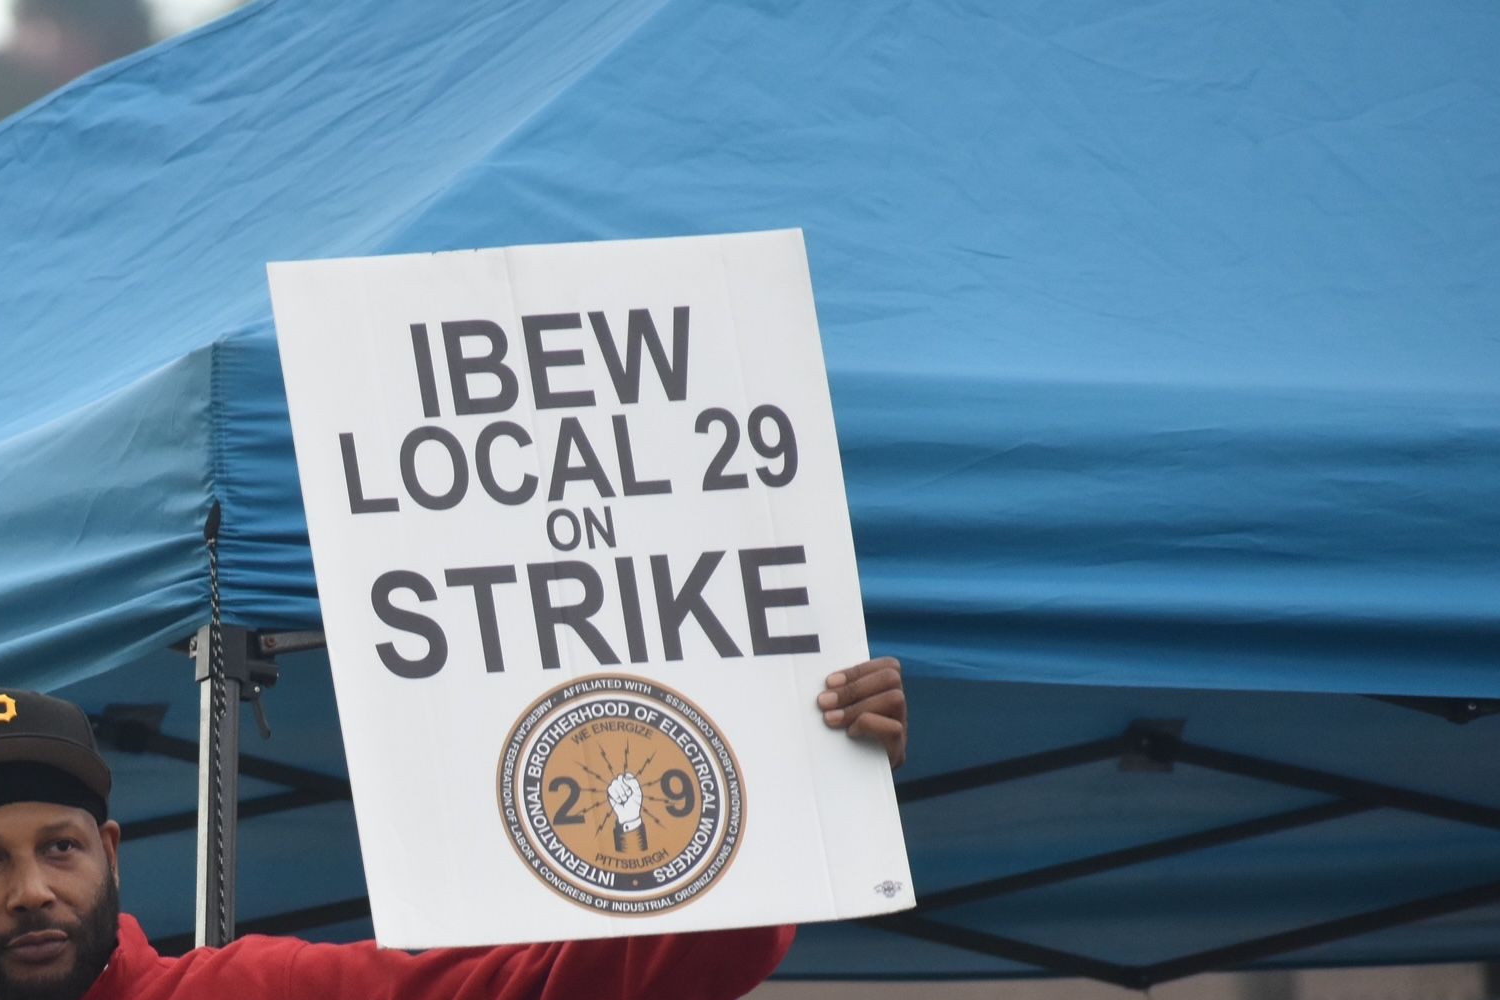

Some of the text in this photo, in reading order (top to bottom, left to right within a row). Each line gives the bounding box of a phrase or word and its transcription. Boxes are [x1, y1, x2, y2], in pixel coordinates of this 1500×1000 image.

[410, 307, 689, 418] IBEW
[339, 405, 798, 514] LOCAL 29
[547, 507, 616, 551] ON
[371, 546, 820, 679] STRIKE
[563, 679, 652, 699] AFFILIATED WITH
[513, 698, 553, 741] AMERICAN
[571, 721, 653, 745] WE ENERGIZE
[665, 693, 713, 737] CONGRESS
[503, 742, 519, 807] FEDERATION
[711, 737, 736, 780] LABOUR
[506, 808, 517, 823] OF
[526, 702, 716, 887] INTERNATIONAL BROTHERHOOD OF ELECTRICAL WORKERS
[548, 769, 695, 826] 2 9
[729, 780, 741, 834] CANADIAN
[511, 824, 535, 860] LABOR
[595, 848, 668, 869] PITTSBURGH
[726, 836, 735, 845] &
[532, 860, 541, 868] &
[540, 866, 593, 905] CONGRESS
[595, 899, 610, 909] OF
[612, 896, 674, 912] INDUSTRIAL
